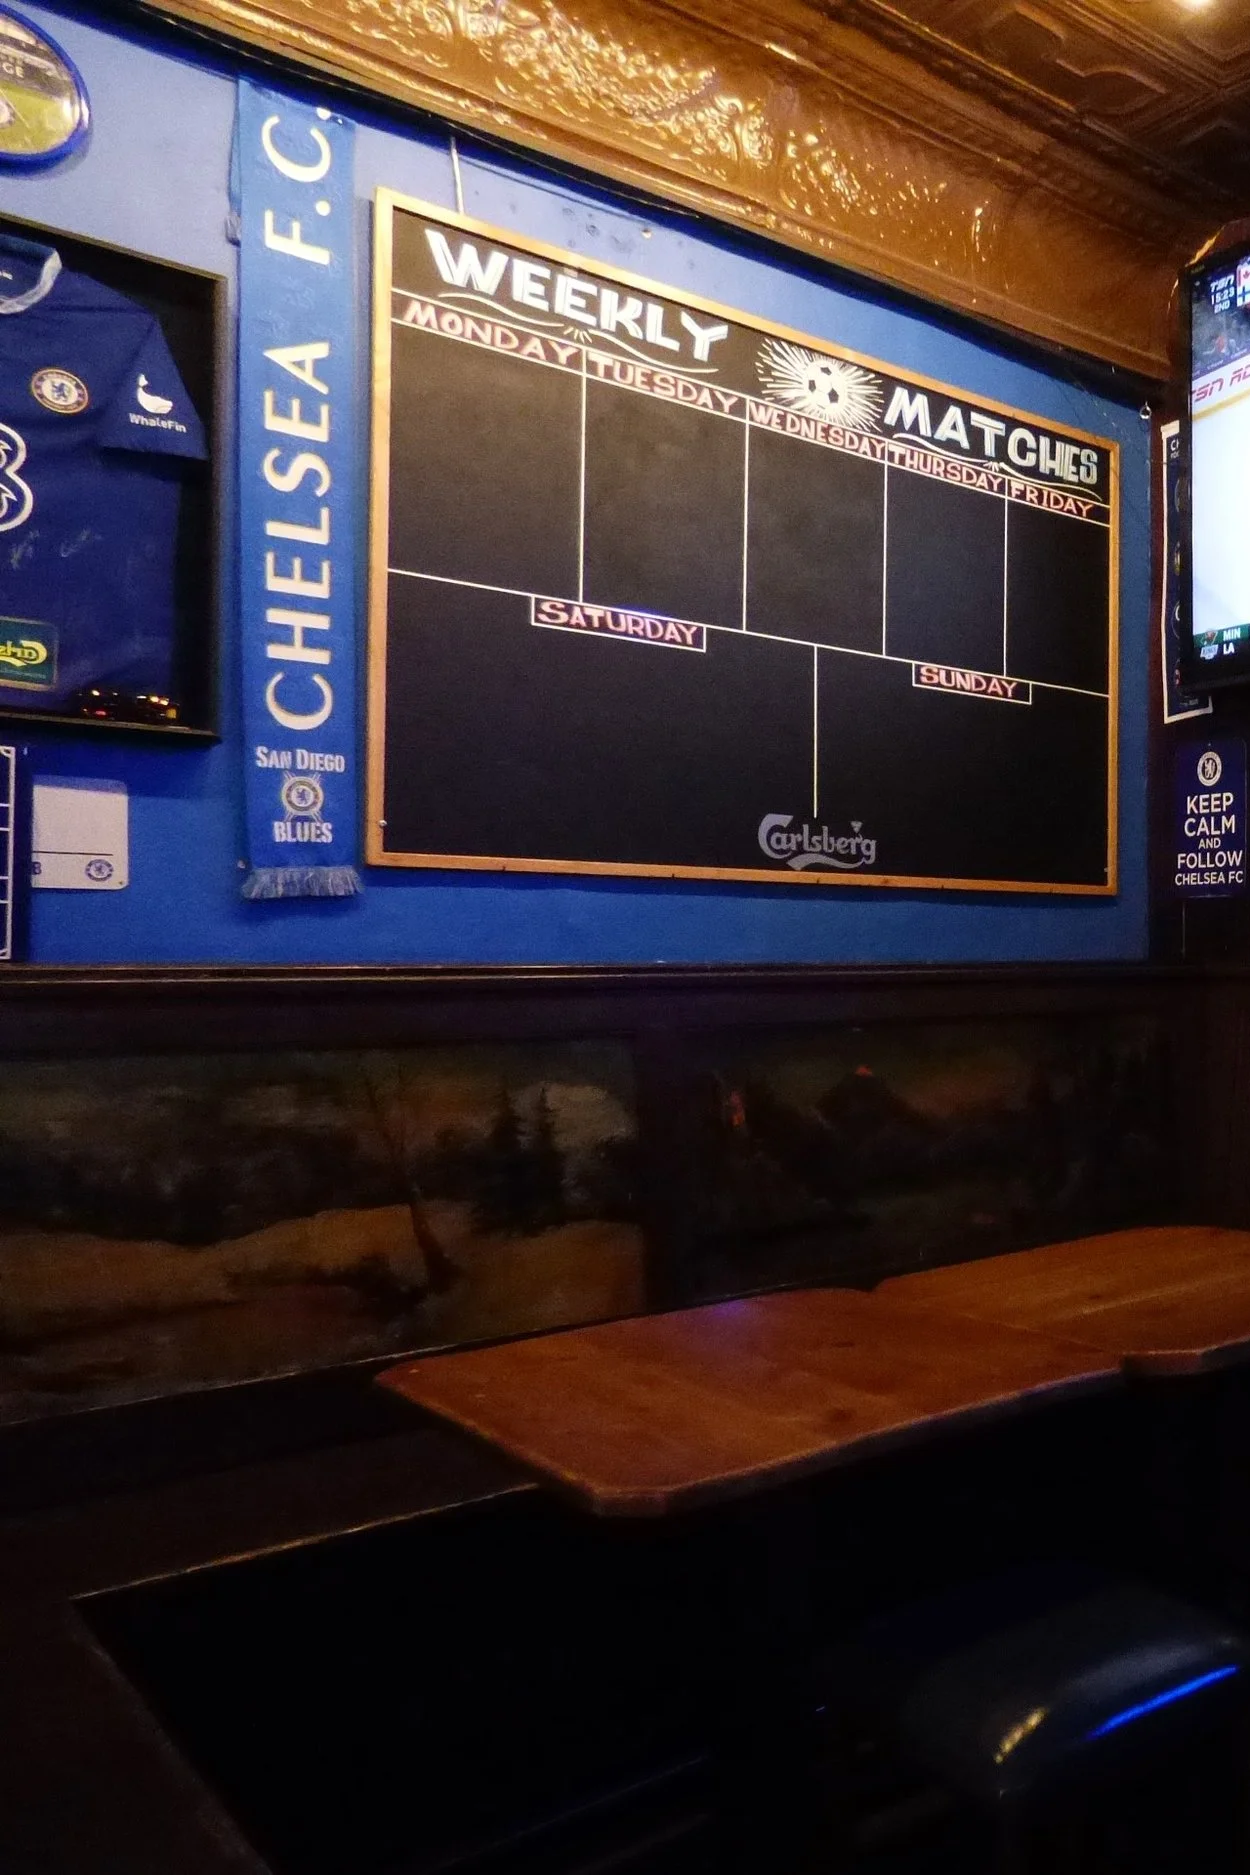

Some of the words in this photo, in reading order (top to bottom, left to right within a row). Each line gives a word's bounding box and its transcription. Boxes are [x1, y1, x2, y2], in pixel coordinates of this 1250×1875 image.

[262, 107, 332, 266] F.C.
[1210, 274, 1234, 292] TSN
[424, 228, 728, 362] WEEKLY
[403, 299, 580, 367] MONDAY
[587, 352, 740, 414] TUESDAY
[749, 401, 885, 460] WEDNESDAY
[888, 445, 1003, 493] THURSDAY
[1011, 482, 1095, 518] FRIDAY
[128, 412, 188, 434] WhaleFin
[884, 386, 1098, 487] MATCHES
[262, 342, 333, 731] CHELSEA
[537, 600, 699, 647] SATURDAY
[1223, 627, 1241, 642] MIN
[1223, 642, 1235, 655] LA
[919, 665, 1018, 699] SUNDAY
[255, 746, 291, 770] SAN
[296, 747, 345, 773] DIEGO
[1186, 792, 1234, 815] KEEP
[273, 821, 333, 844] BLUES
[1184, 814, 1235, 837] CALM
[758, 813, 877, 866] Carlsberg
[1198, 837, 1221, 850] AND
[1177, 850, 1243, 870] FOLLOW
[1175, 871, 1226, 887] CHELSEA
[1228, 869, 1244, 885] FC
